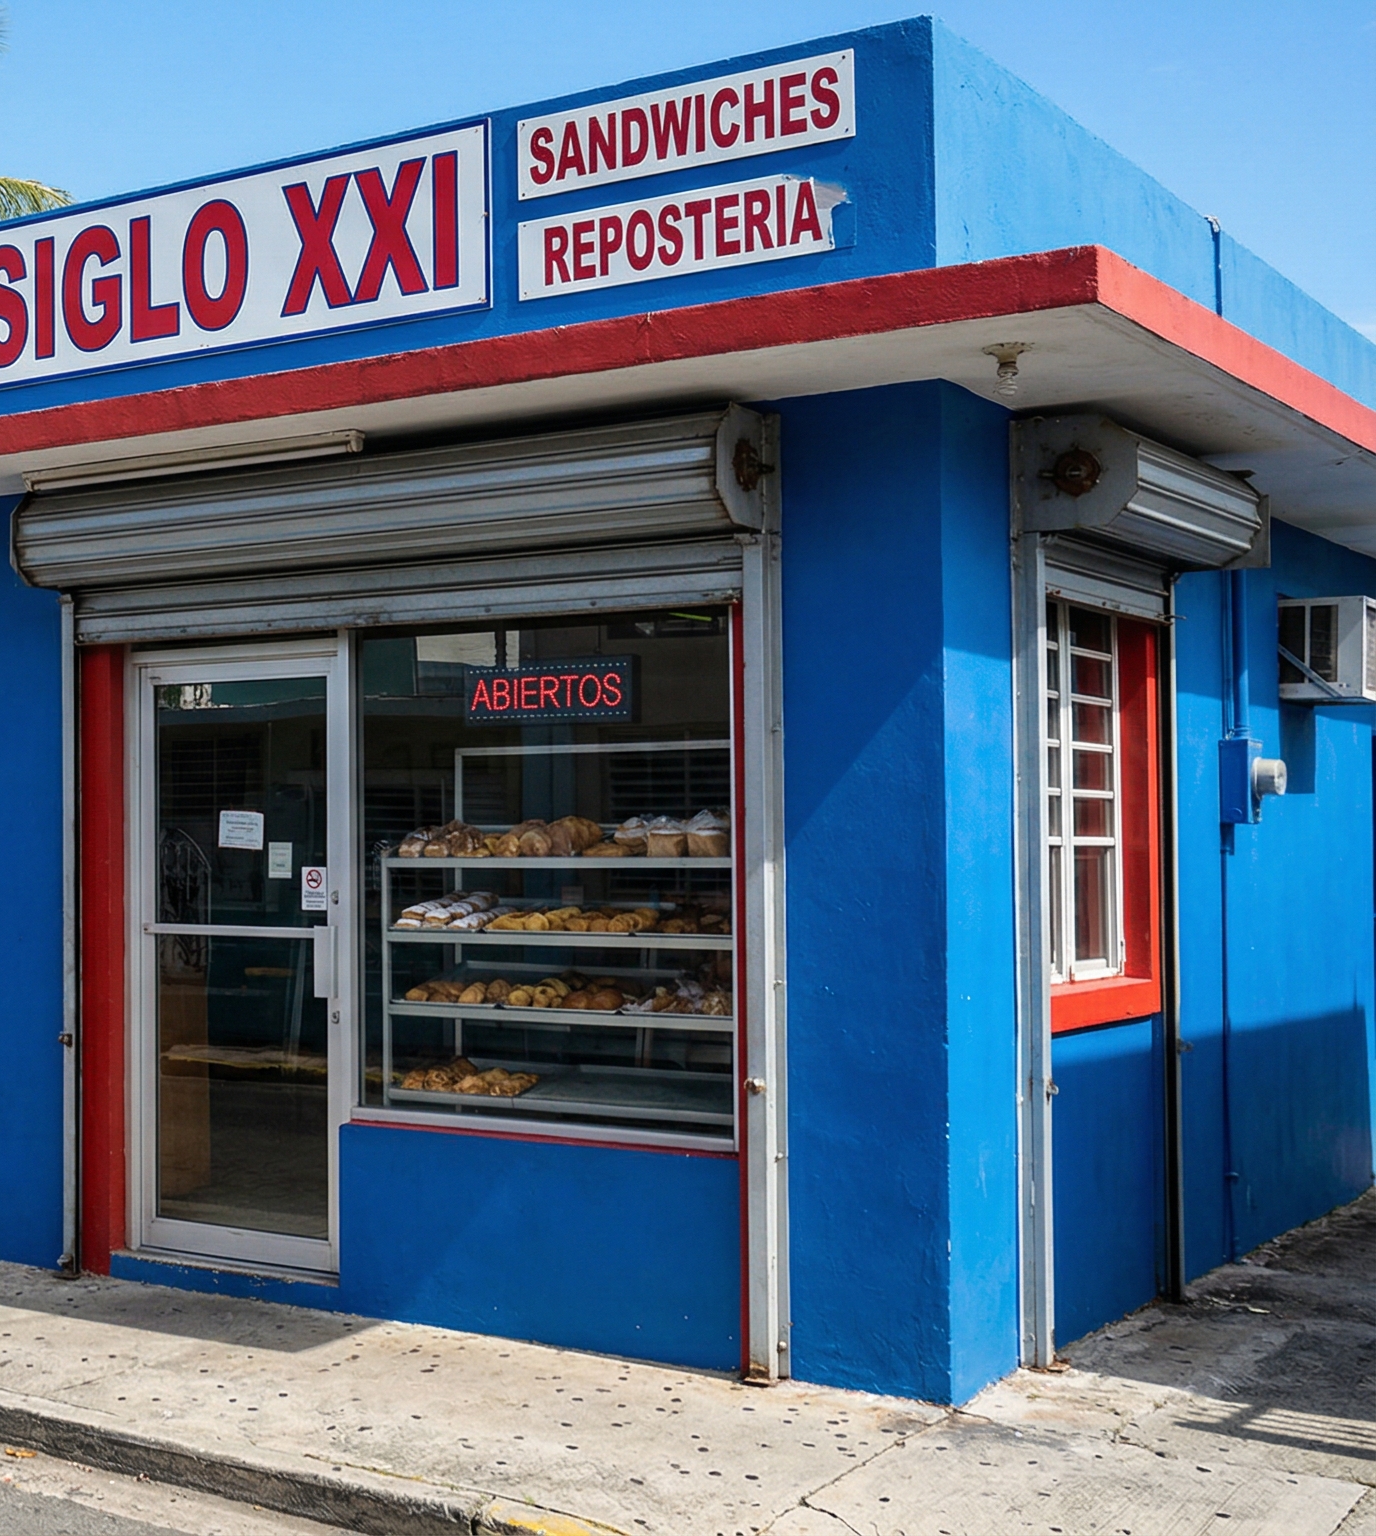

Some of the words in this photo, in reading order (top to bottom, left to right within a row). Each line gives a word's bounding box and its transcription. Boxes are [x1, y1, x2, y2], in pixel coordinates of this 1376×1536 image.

[529, 66, 841, 185] SANDWICHES
[280, 150, 459, 318] XXI
[543, 180, 824, 287] REPOSTERIA
[470, 672, 622, 711] ABIERTOS
